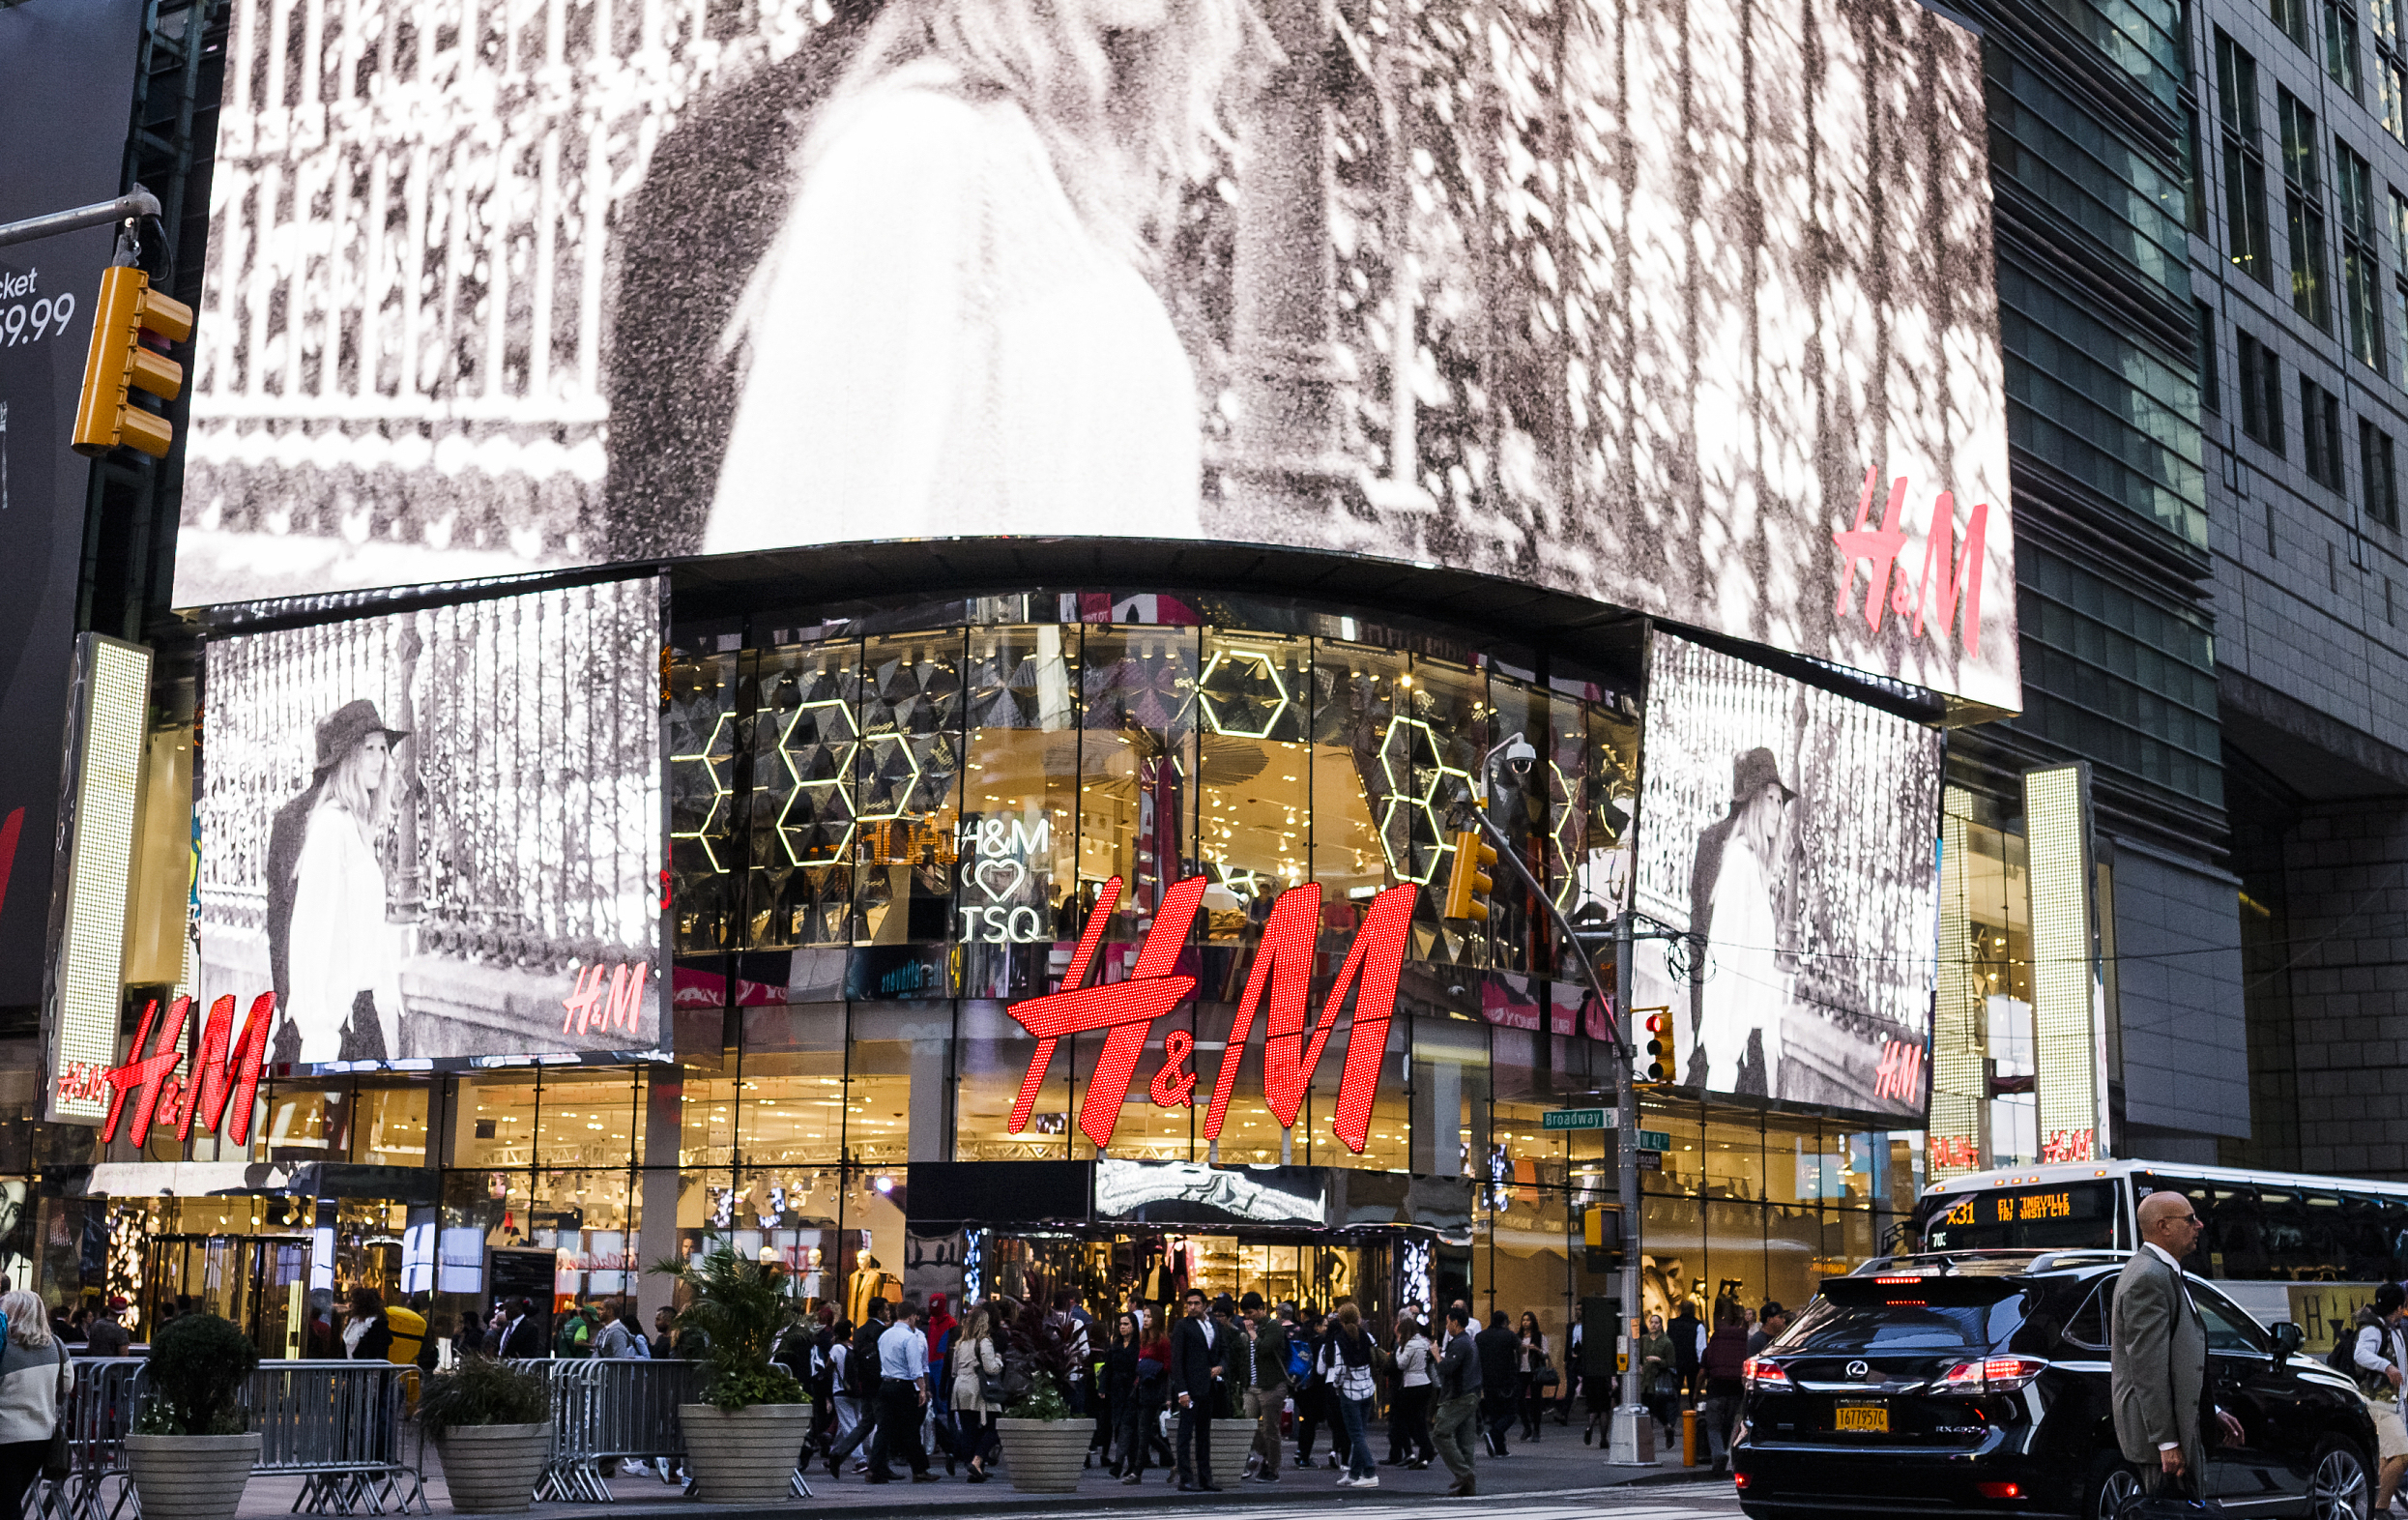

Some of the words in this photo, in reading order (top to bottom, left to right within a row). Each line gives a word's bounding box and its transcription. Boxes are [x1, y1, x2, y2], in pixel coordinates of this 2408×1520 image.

[1833, 464, 1988, 659] H&M
[953, 818, 1049, 859] H&M
[959, 905, 1040, 944] TSQ
[562, 960, 647, 1037] H&M
[1006, 874, 1417, 1155] H&M
[57, 1062, 110, 1105] H&M
[101, 991, 276, 1148] H&M
[1873, 1039, 1923, 1104] H&M
[1546, 1112, 1601, 1127] Broadway
[1641, 1132, 1650, 1148] W
[1652, 1133, 1662, 1150] 42
[2043, 1128, 2094, 1165] H&M
[2050, 1206, 2071, 1218] CTR
[1839, 1410, 1885, 1425] T677957C
